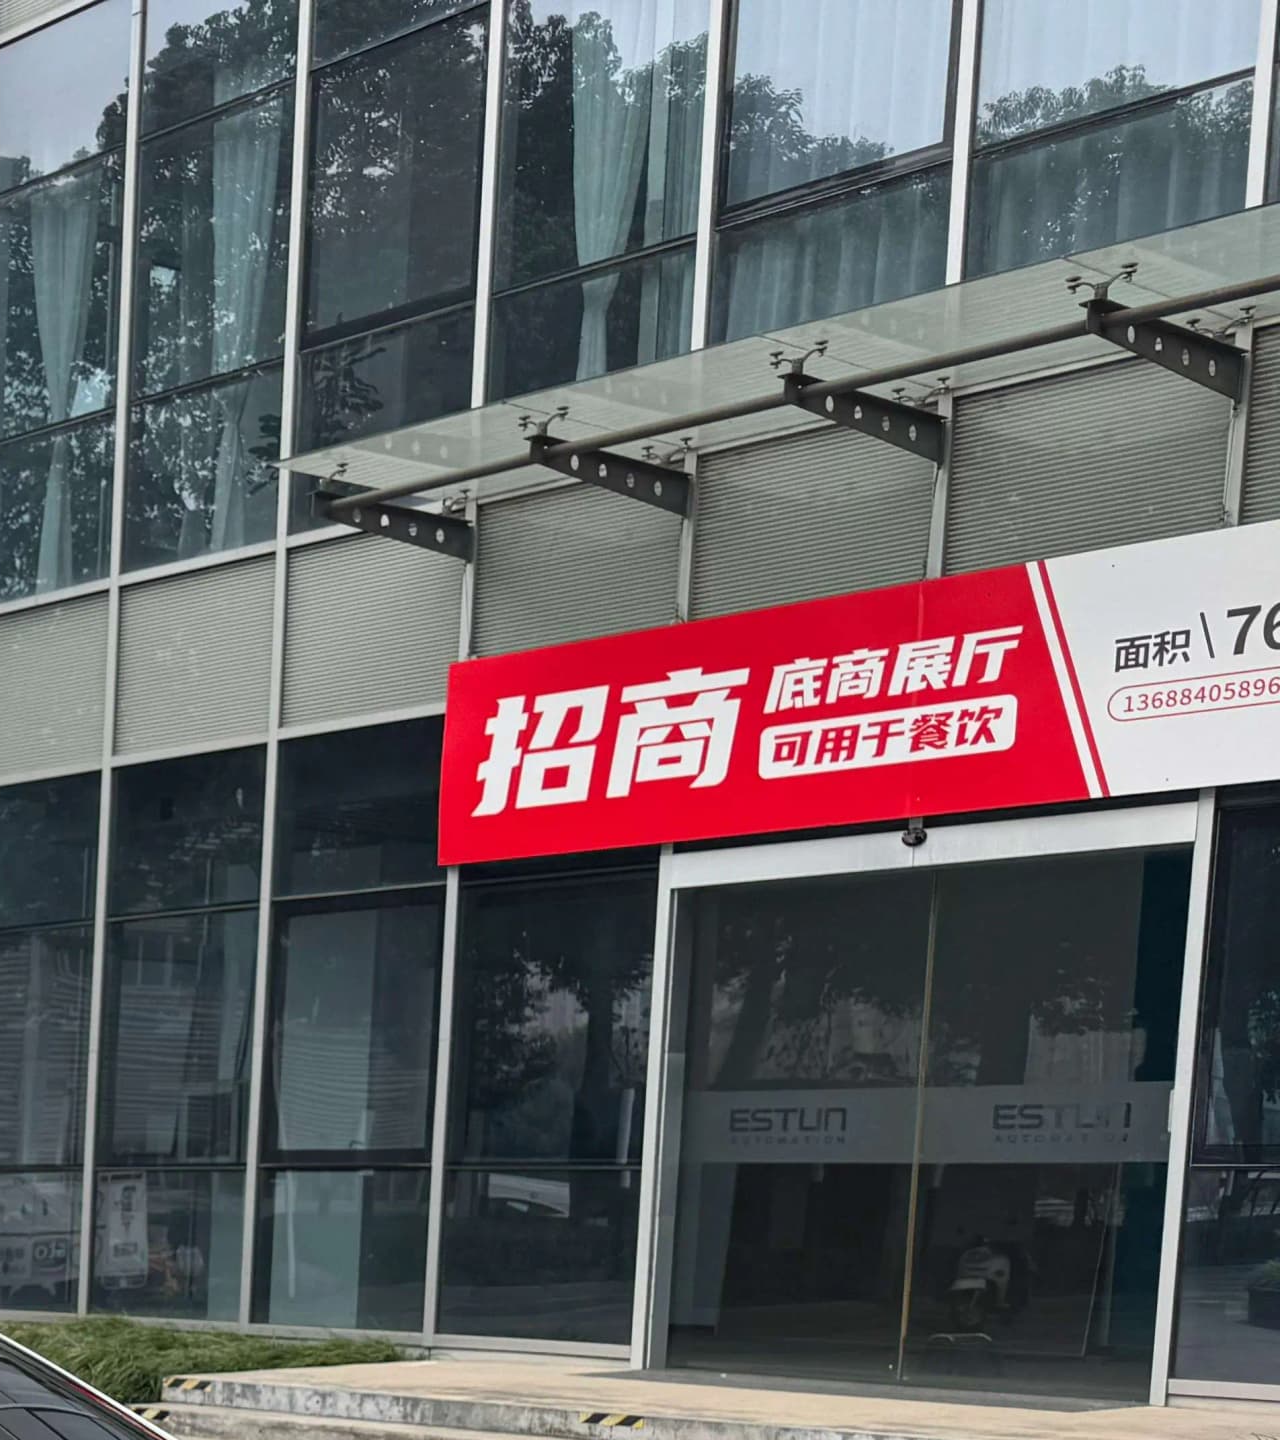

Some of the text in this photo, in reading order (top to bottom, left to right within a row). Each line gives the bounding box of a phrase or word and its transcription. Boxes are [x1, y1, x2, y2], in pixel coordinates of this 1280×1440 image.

[762, 625, 1024, 715] 底商展厅
[1114, 629, 1191, 673] 面积
[1123, 676, 1280, 713] 13688405896
[470, 666, 750, 817] 招商
[772, 705, 1004, 767] 可用于餐饮
[730, 1107, 846, 1132] ESTUN
